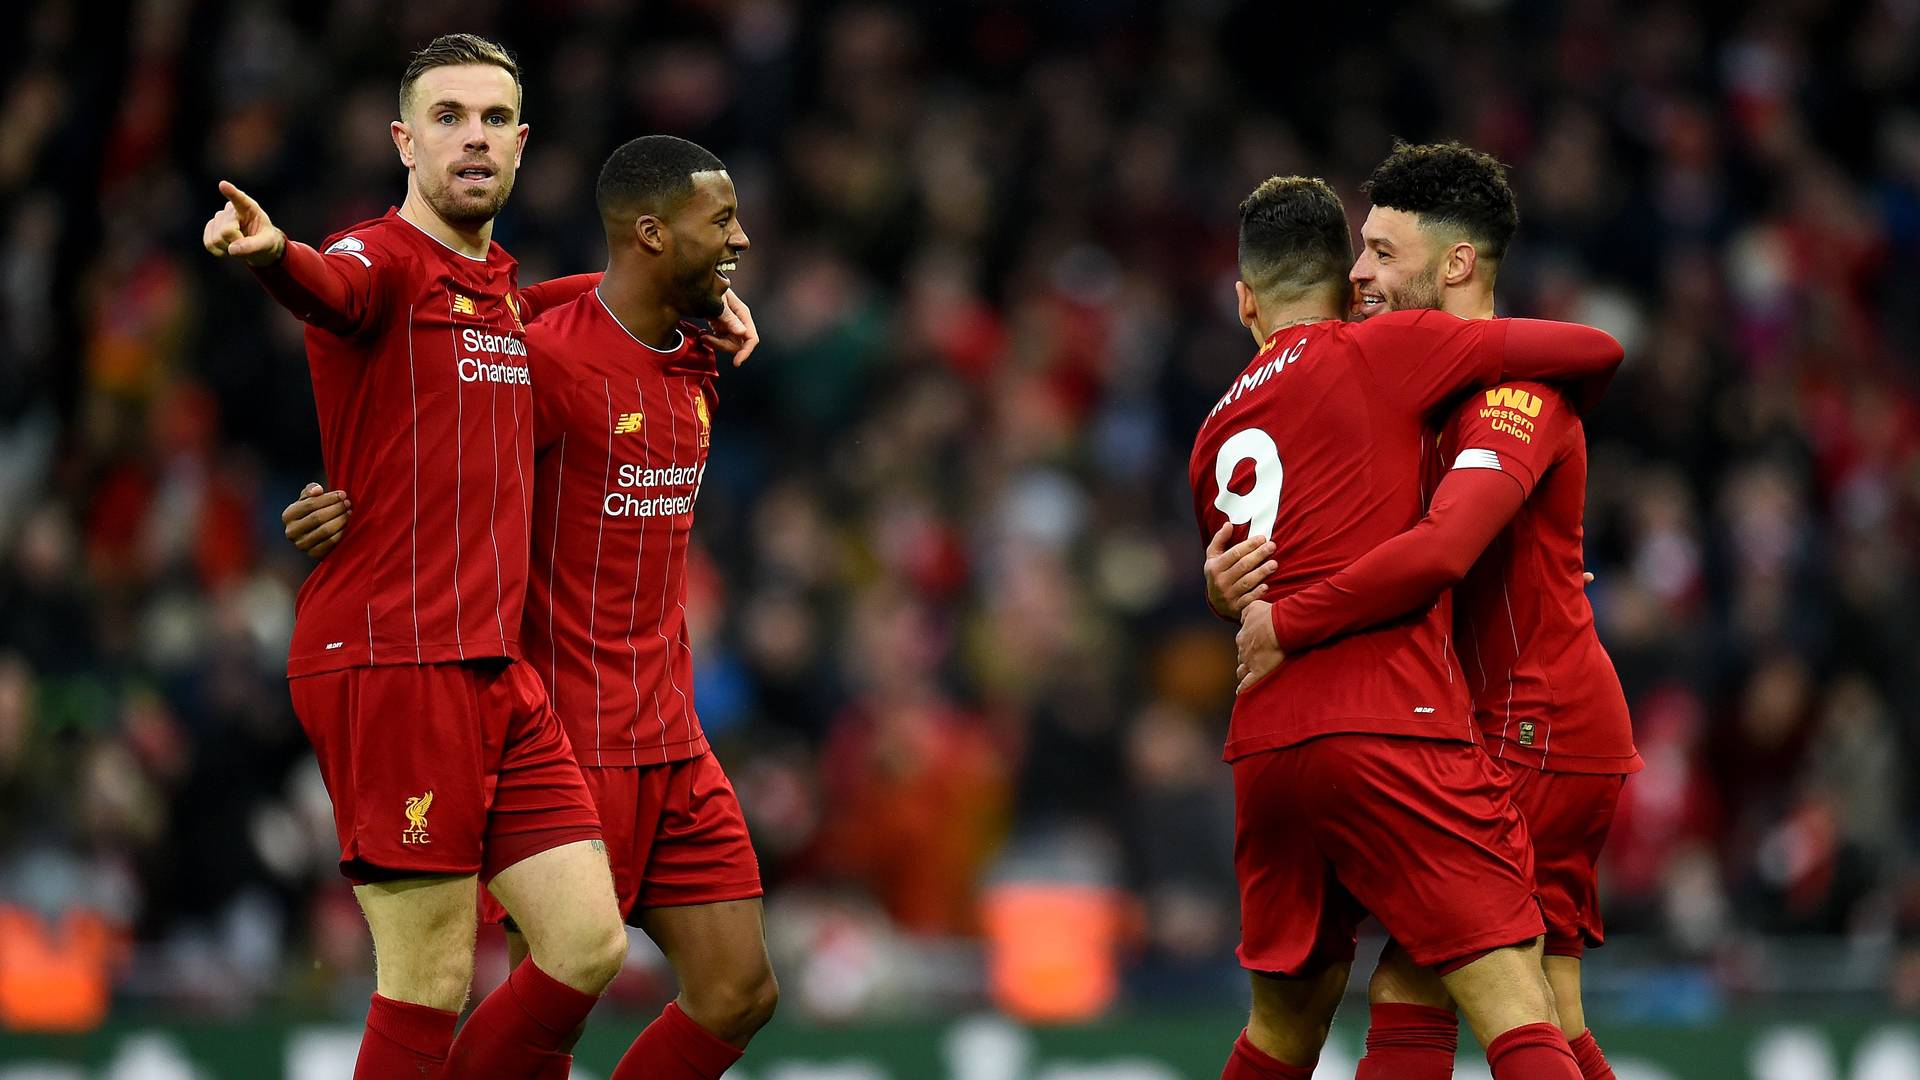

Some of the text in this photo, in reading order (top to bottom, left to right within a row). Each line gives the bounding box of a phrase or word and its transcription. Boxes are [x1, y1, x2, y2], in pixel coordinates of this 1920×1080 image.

[1485, 387, 1543, 418] WU
[1479, 407, 1535, 433] Western
[1491, 418, 1531, 445] Union
[617, 462, 698, 488] Standard
[1213, 427, 1284, 543] 9
[604, 491, 693, 517] Chartered
